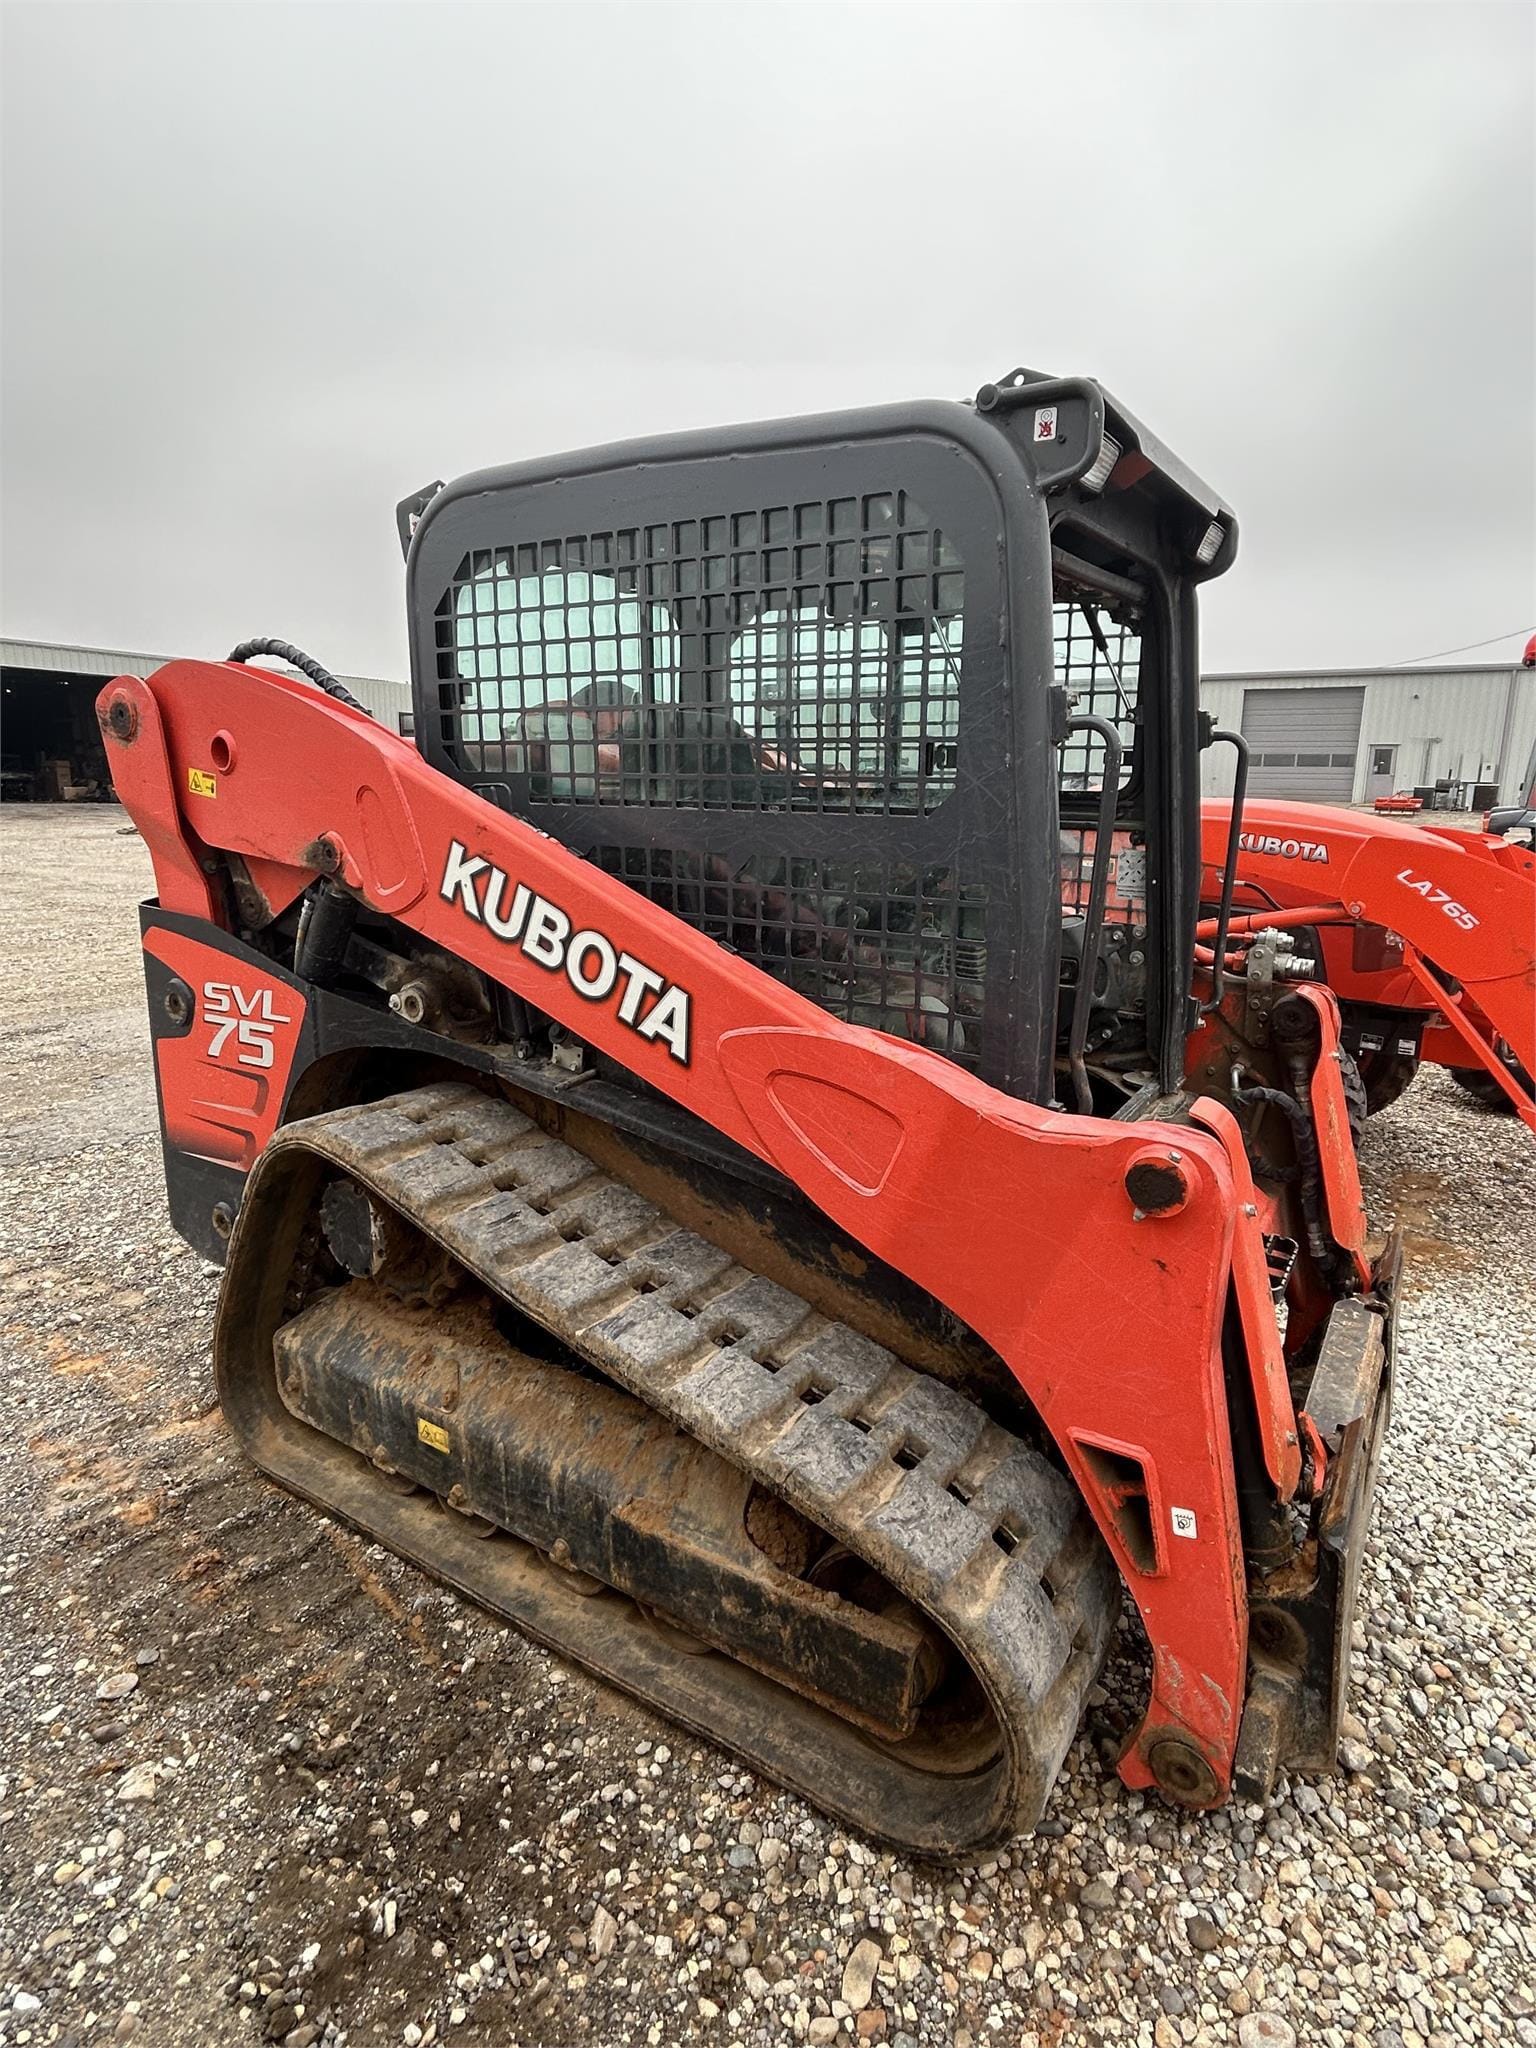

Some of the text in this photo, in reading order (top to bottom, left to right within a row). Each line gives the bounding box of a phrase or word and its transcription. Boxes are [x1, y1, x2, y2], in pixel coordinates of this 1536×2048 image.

[1396, 868, 1481, 930] LA765
[440, 839, 691, 1065] KUBOTA
[203, 981, 291, 1024] SVL
[203, 1013, 275, 1068] 75
